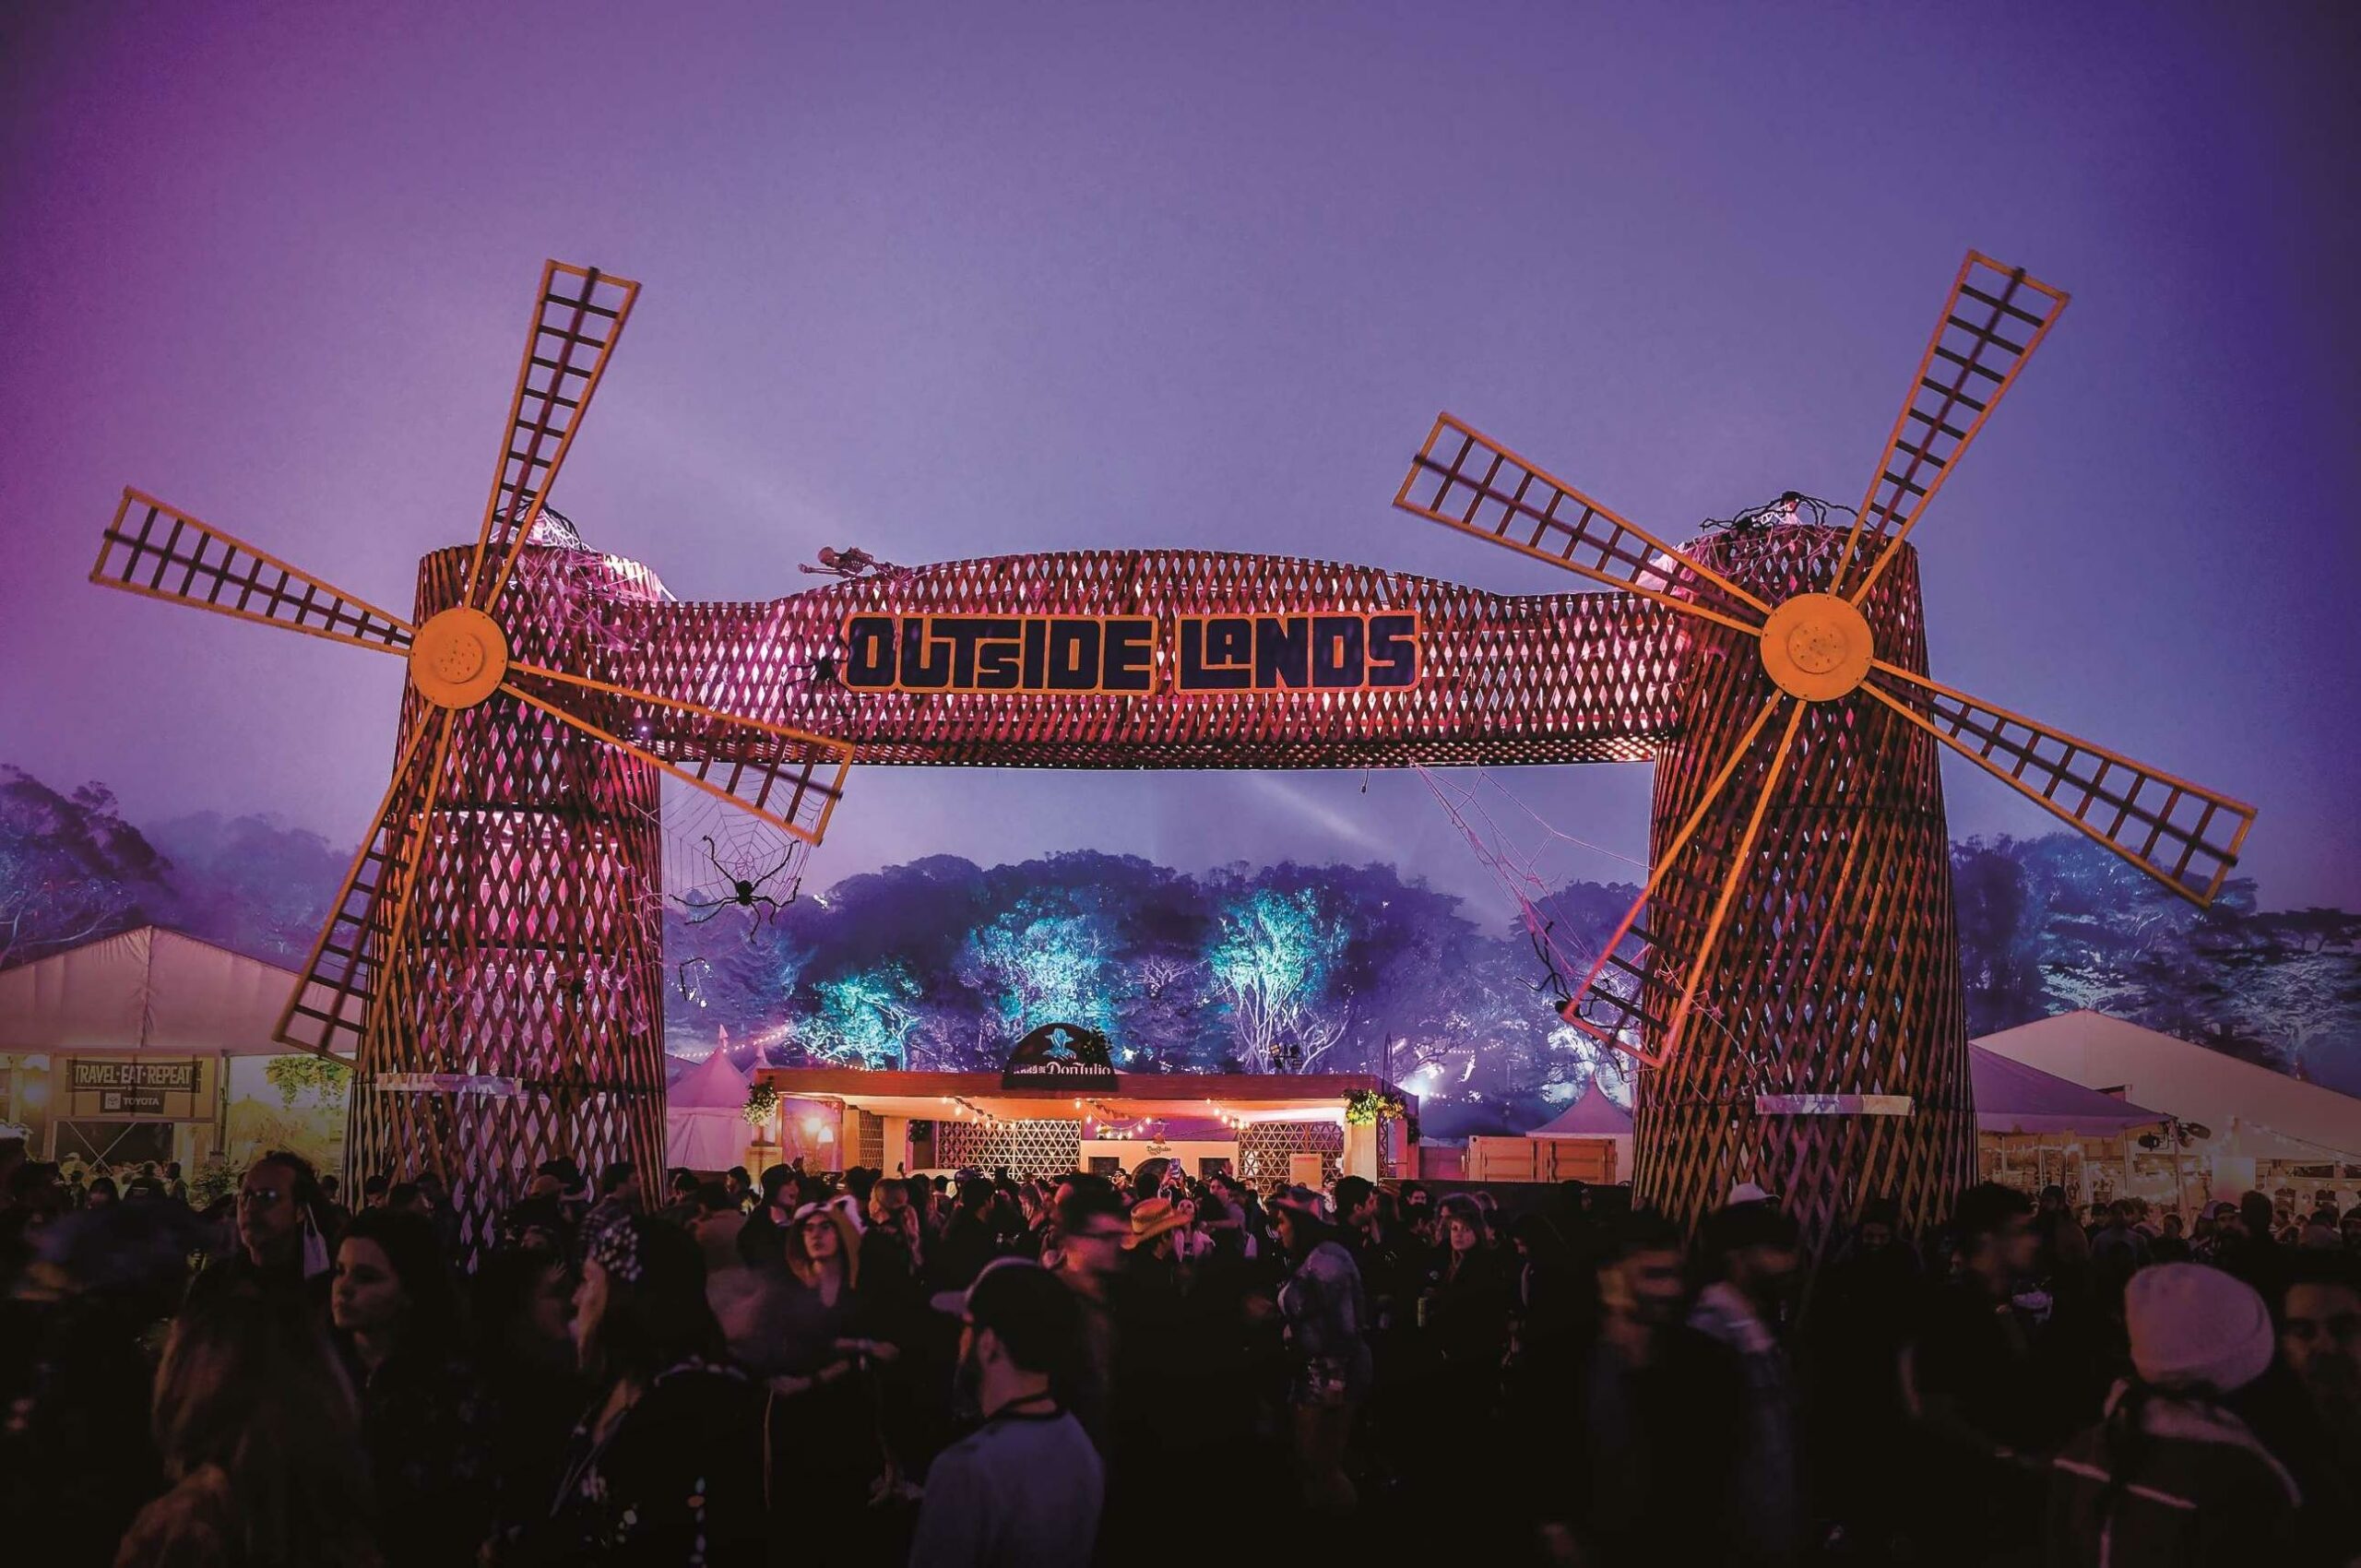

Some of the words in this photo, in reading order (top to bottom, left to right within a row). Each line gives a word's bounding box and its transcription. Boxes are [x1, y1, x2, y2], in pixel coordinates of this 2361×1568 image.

[843, 614, 1157, 693] OUTSIDE
[1175, 613, 1419, 693] LANDS
[123, 1097, 160, 1106] TOYOTA
